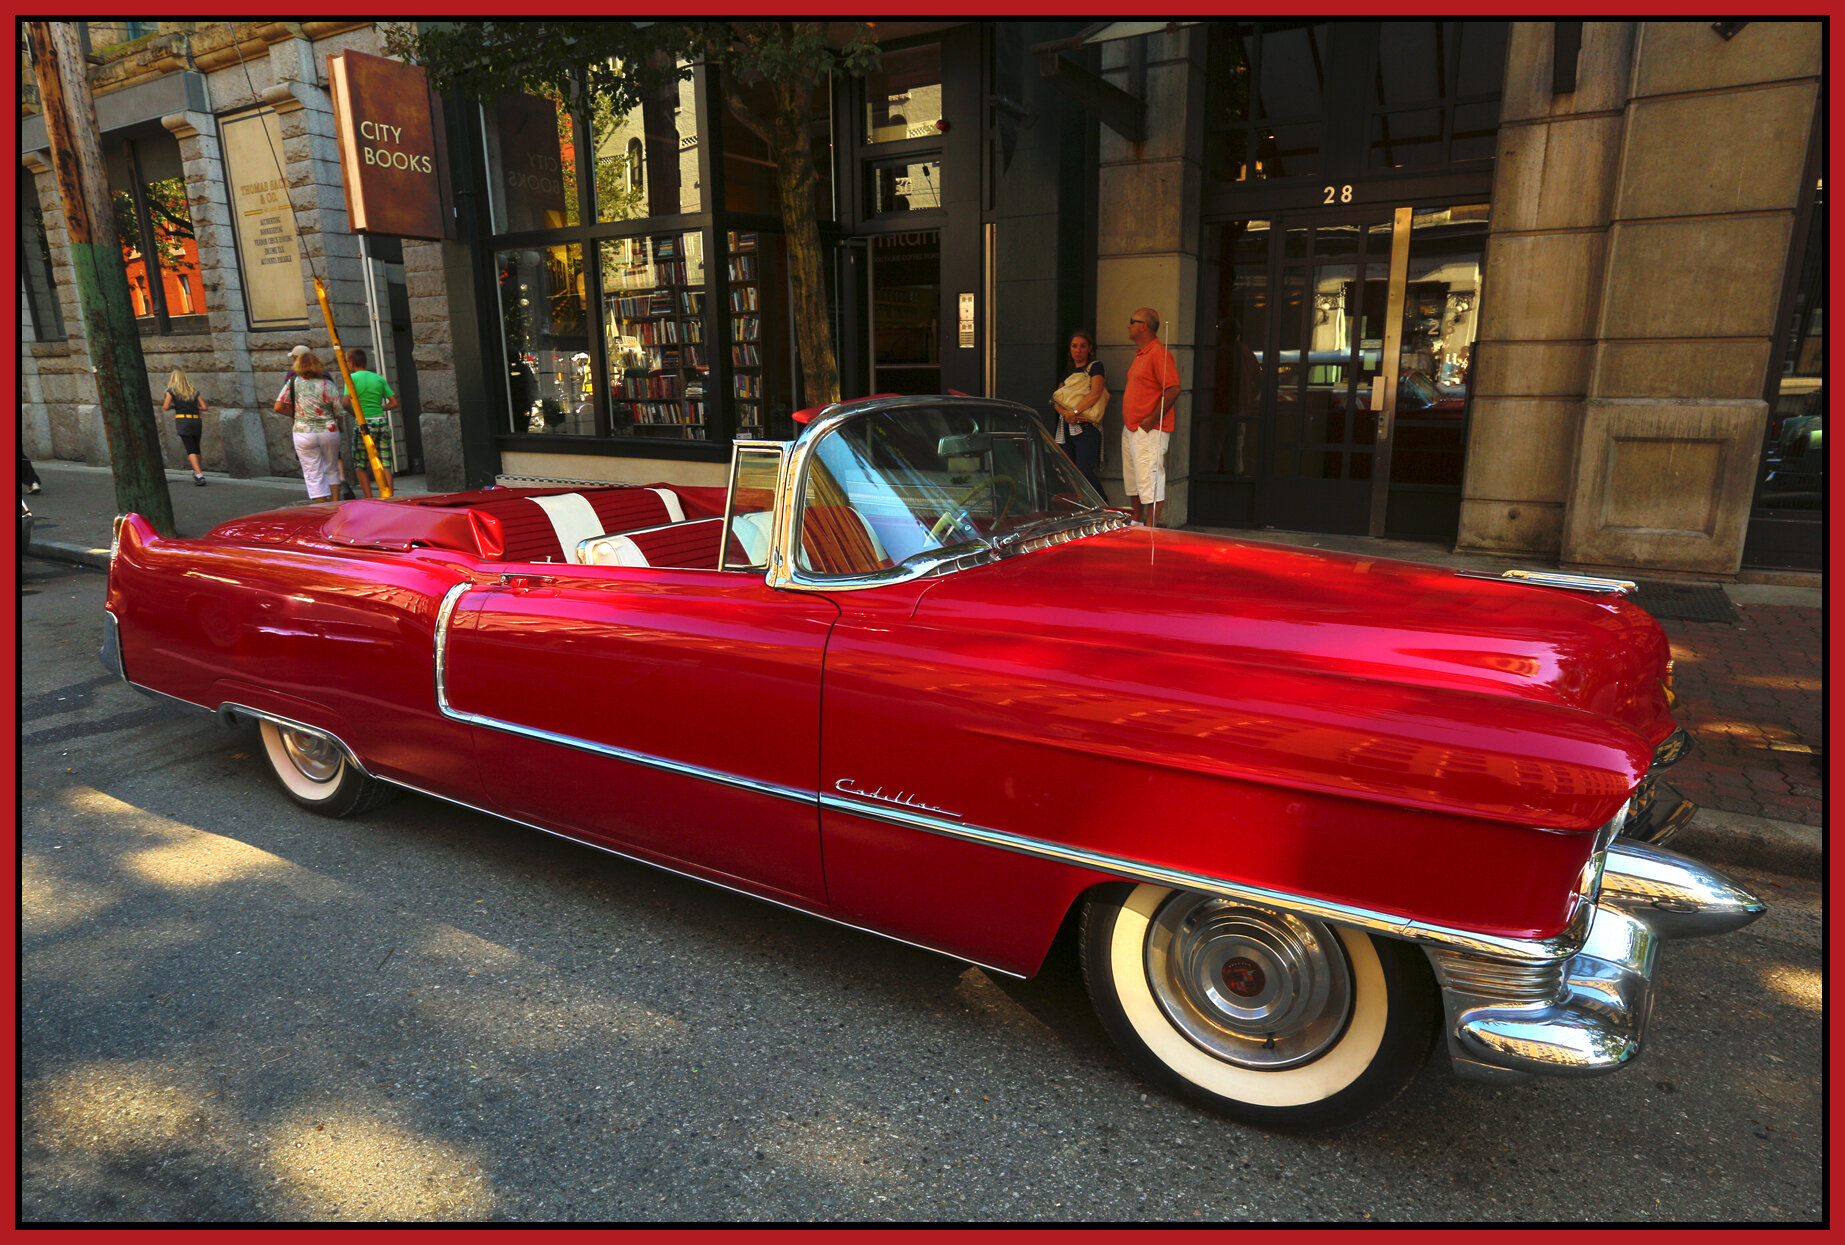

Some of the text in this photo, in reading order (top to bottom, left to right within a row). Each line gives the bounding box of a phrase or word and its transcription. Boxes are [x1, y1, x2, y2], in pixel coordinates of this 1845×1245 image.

[360, 121, 402, 145] CITY
[364, 147, 432, 174] BOOKS
[240, 181, 269, 196] THOMAS
[1323, 184, 1353, 204] 28
[835, 778, 962, 817] Cadillac
